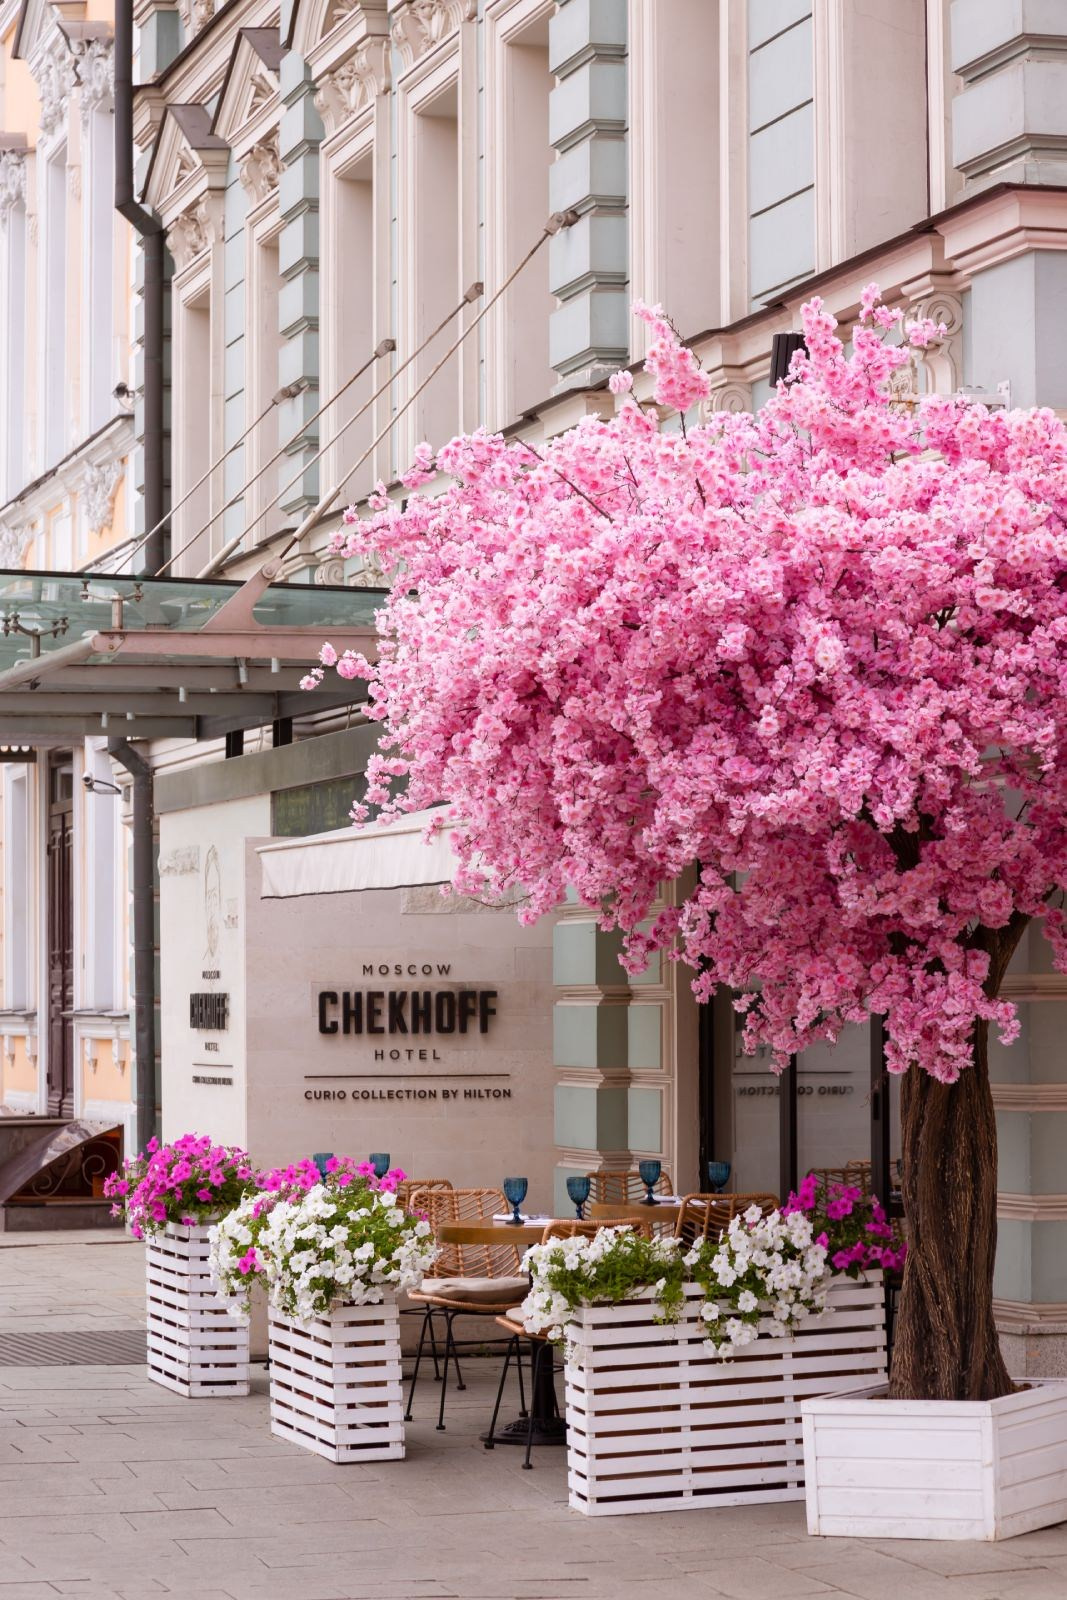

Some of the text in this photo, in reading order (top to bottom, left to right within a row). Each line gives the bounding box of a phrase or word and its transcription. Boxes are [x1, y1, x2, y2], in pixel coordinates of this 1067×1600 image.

[363, 964, 451, 976] MOSCOW
[318, 991, 498, 1034] CHEKHOFF
[374, 1050, 441, 1060] HOTEL
[304, 1088, 512, 1100] CURIO COLLECTION BY HILTON
